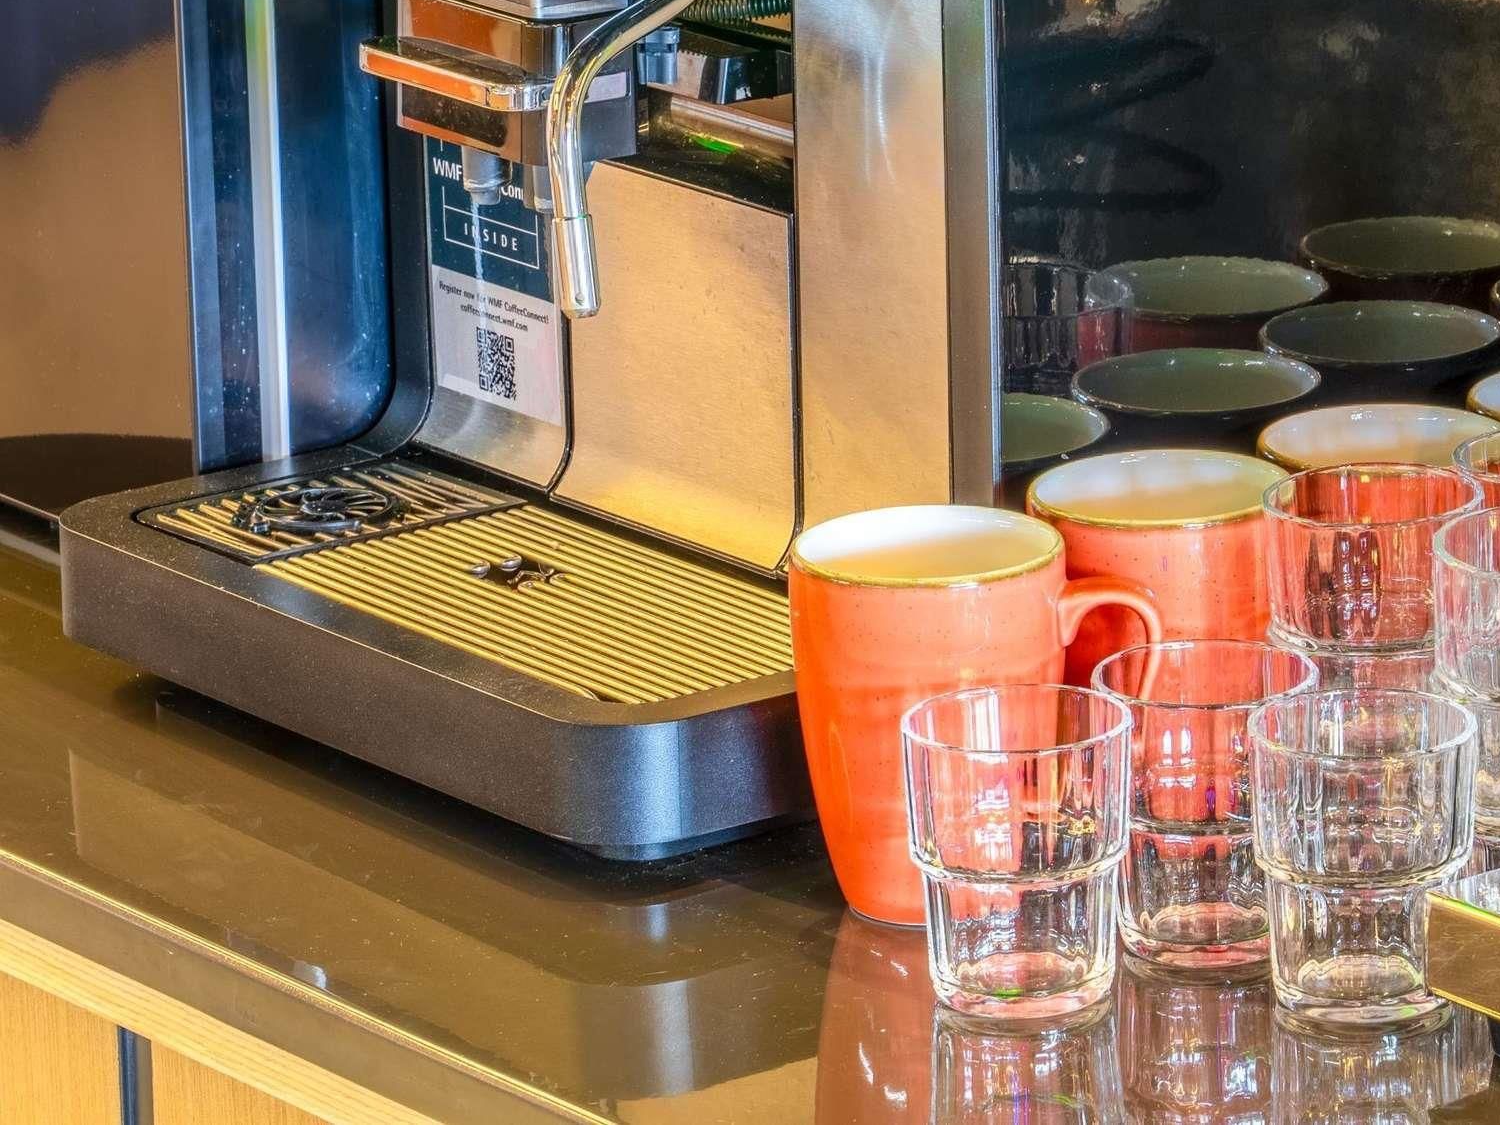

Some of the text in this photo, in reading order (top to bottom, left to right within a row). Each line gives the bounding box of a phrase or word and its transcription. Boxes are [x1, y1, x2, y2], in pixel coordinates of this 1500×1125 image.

[433, 157, 463, 181] WMF
[439, 280, 462, 296] Register
[464, 290, 475, 299] now
[488, 295, 503, 309] WMF
[460, 303, 528, 332] coffeecnnect.wmf.com
